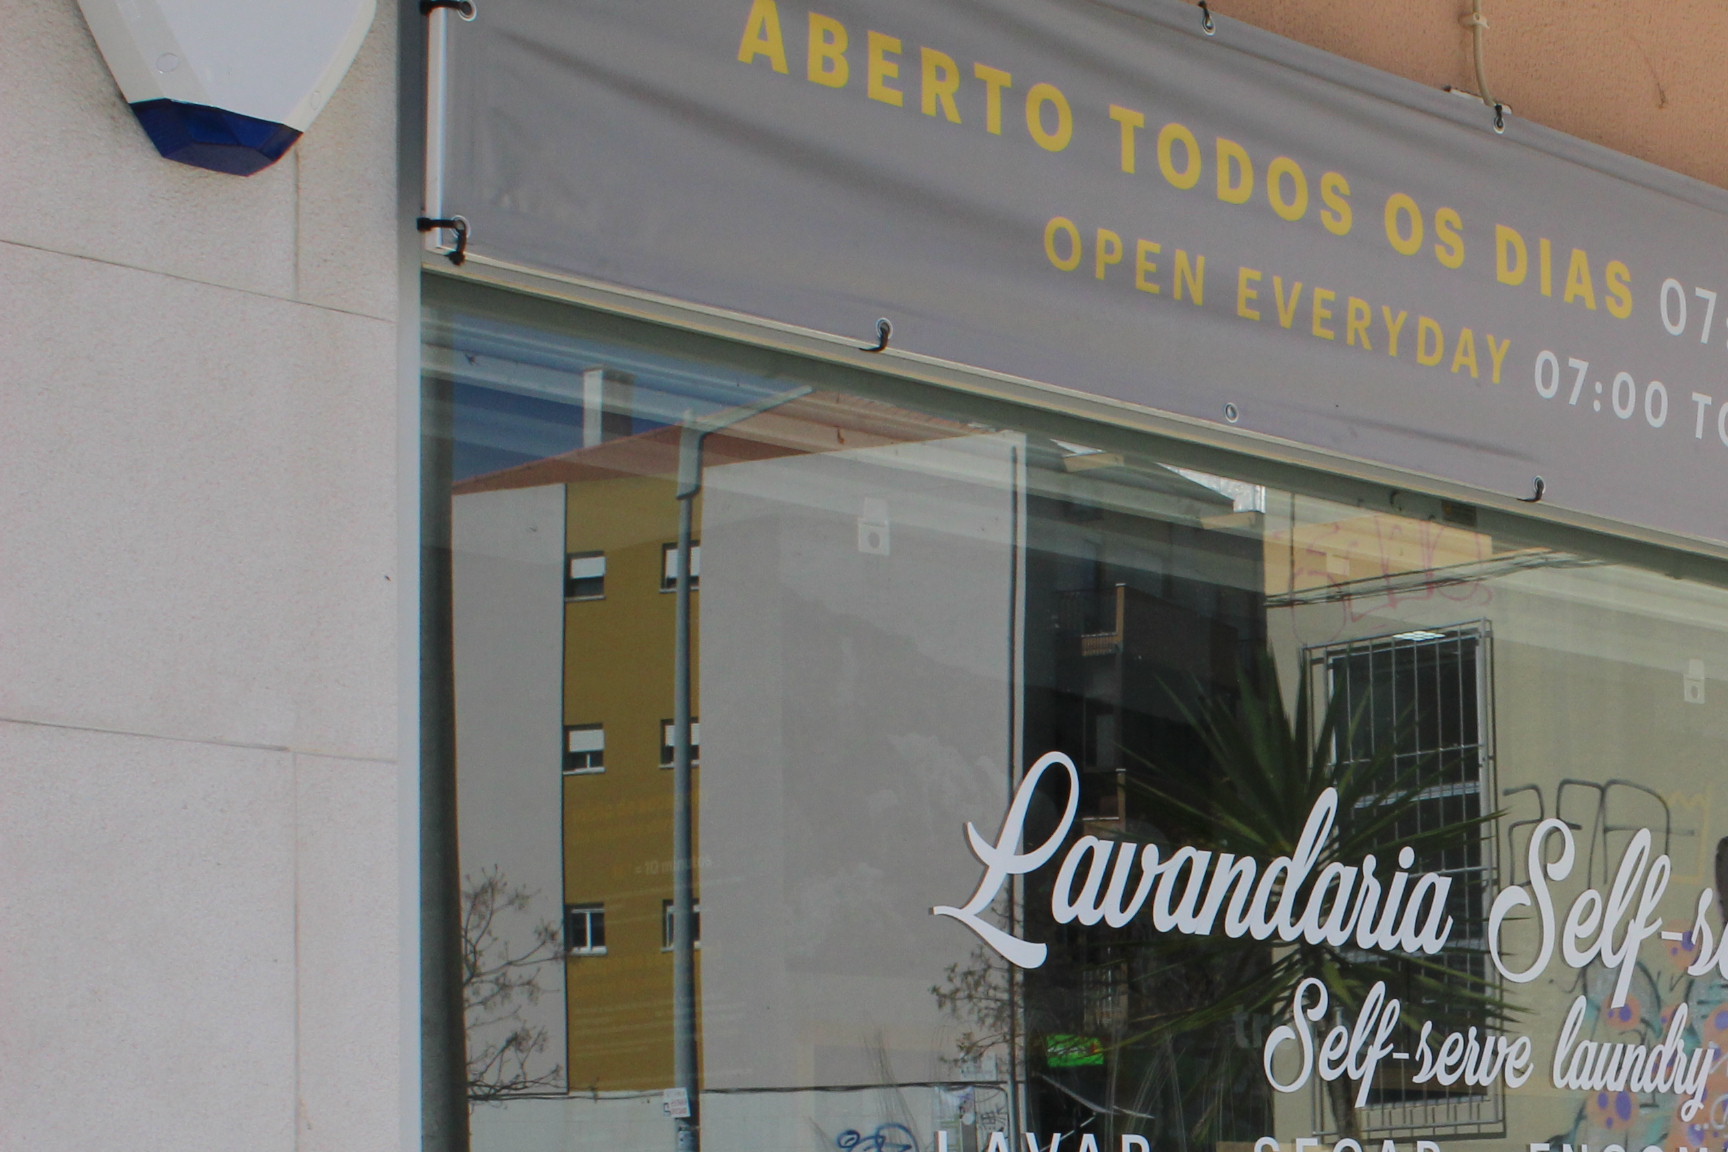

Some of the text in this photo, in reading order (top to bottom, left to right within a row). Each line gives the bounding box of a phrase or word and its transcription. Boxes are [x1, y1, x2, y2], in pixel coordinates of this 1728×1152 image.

[737, 0, 1074, 153] ABERTO
[1109, 104, 1353, 236] TODOS
[1384, 193, 1466, 269] OS
[1495, 225, 1634, 319] DIAS
[1044, 216, 1206, 306] OPEN
[1237, 267, 1511, 385] EVERYDAY
[1533, 350, 1669, 428] 07:00
[932, 750, 1454, 970] Lavandaria
[1263, 976, 1536, 1108] Self-serve
[1552, 994, 1716, 1123] laundry
